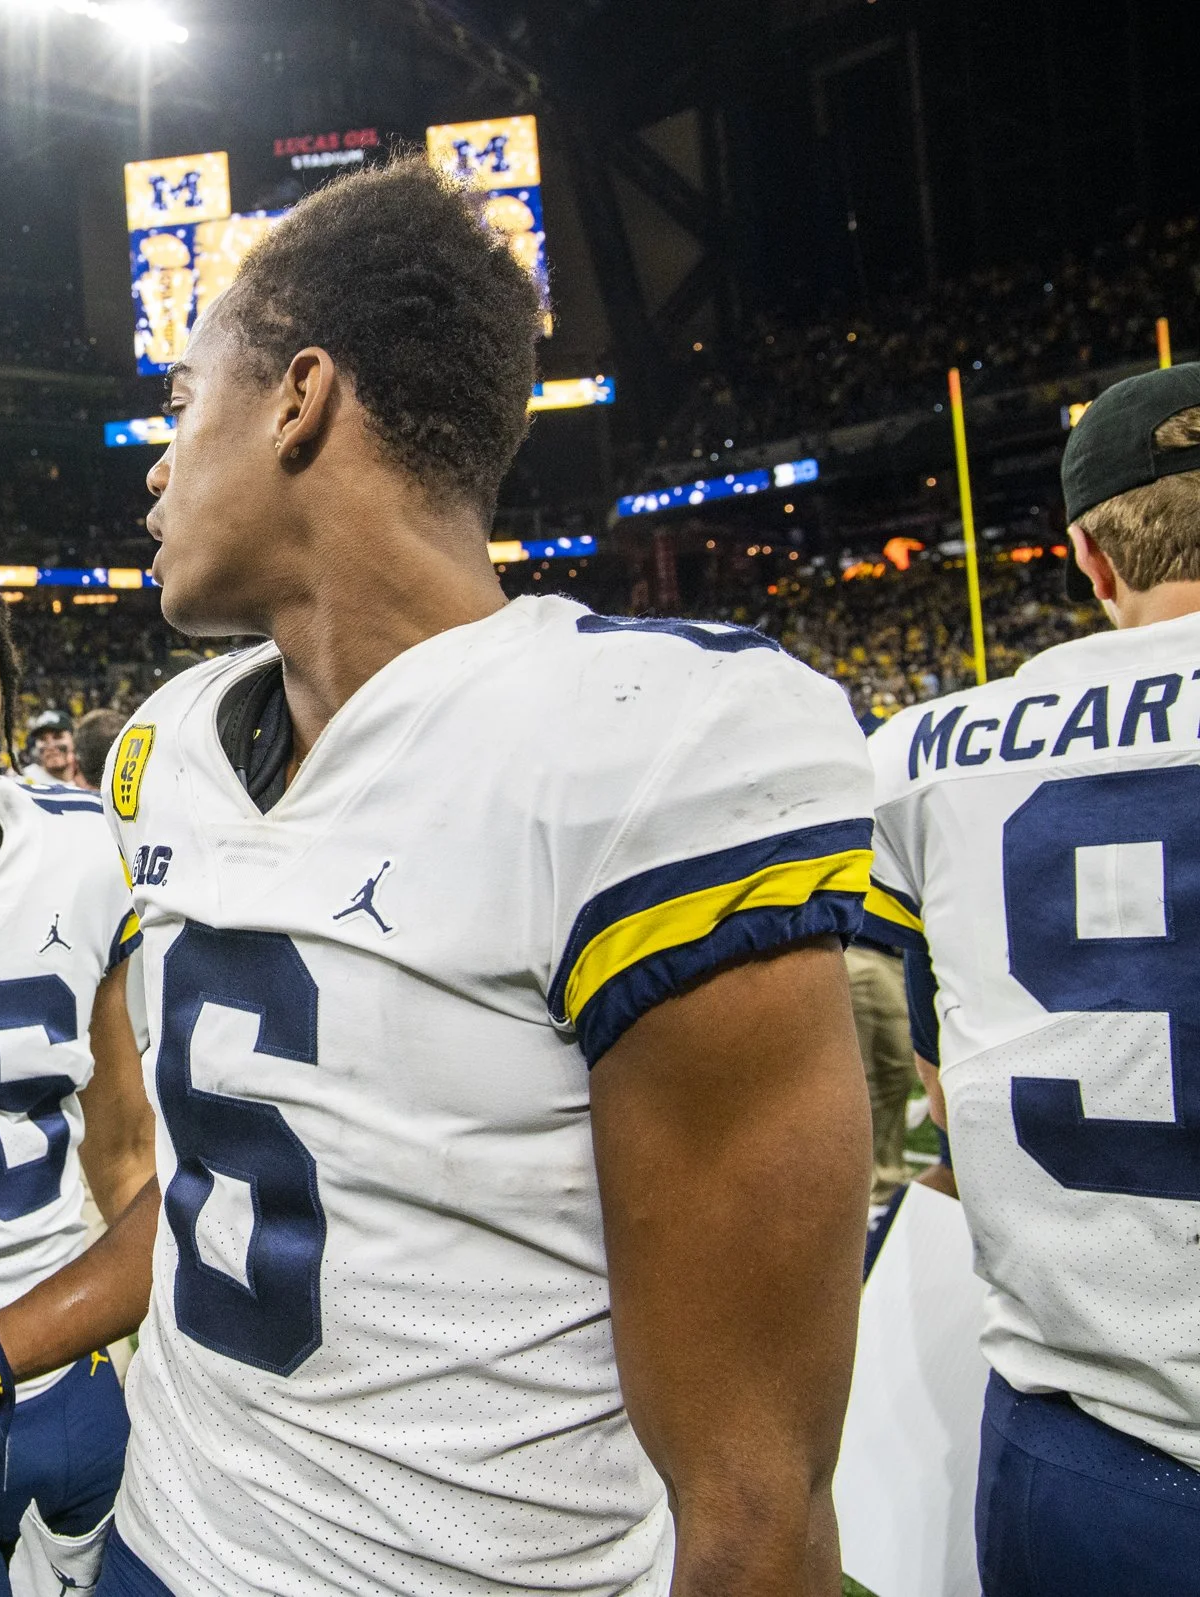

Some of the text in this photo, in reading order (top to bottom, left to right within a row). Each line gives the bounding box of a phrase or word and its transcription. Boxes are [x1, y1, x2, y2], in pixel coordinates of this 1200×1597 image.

[149, 171, 202, 210] M
[125, 738, 145, 760] TM
[120, 760, 137, 782] 42
[155, 921, 327, 1378] 6
